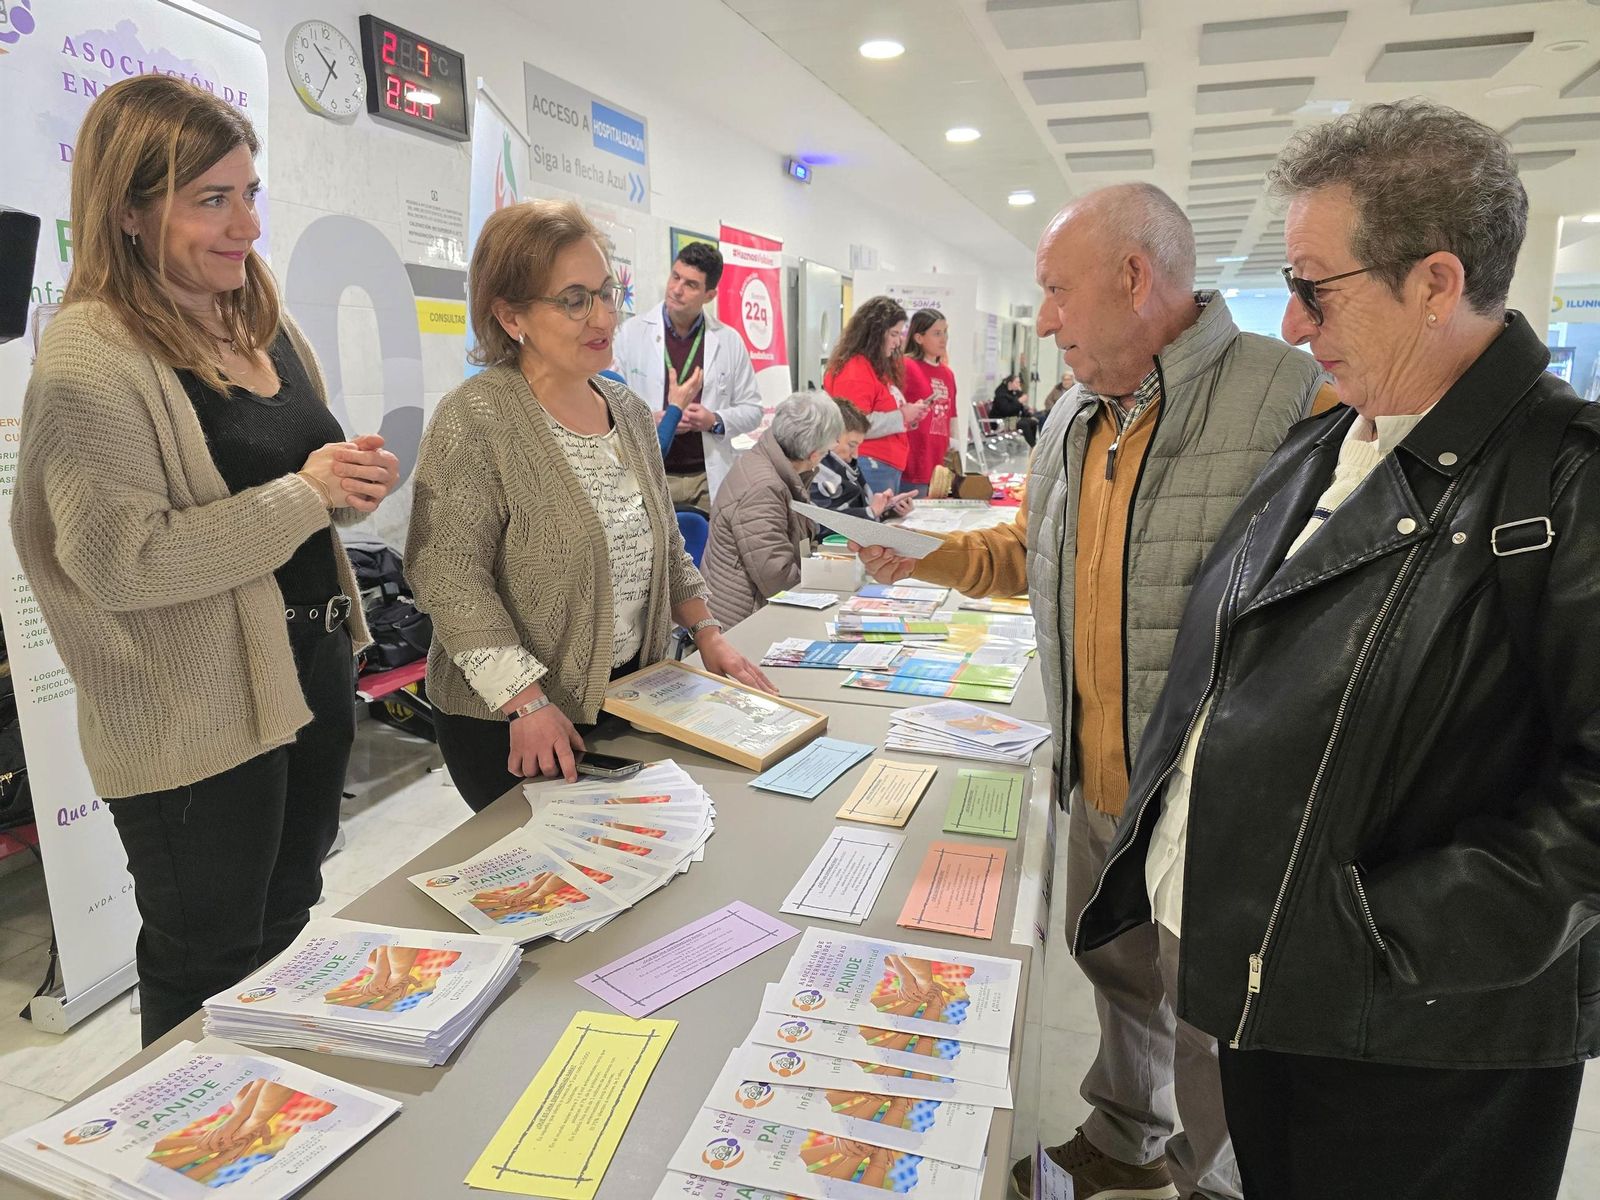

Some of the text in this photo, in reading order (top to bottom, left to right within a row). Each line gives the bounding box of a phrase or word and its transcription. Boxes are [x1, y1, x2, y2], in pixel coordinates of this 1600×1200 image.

[223, 86, 248, 107] DE
[532, 95, 645, 153] ACCESO A HOSPITALIZACIÓN
[534, 144, 627, 191] Siga la flecha Azul
[429, 312, 466, 325] CONSULTAS
[745, 301, 768, 327] 22q
[57, 804, 87, 826] Que
[469, 864, 527, 886] PANIDE
[88, 895, 117, 914] AVDA.
[305, 937, 318, 946] DE
[293, 954, 348, 990] PANIDE
[798, 940, 824, 985] ASOCIACIÓN DE
[805, 941, 832, 987] ENFERMEDADES
[823, 945, 846, 987] DISCAPACIDAD
[835, 956, 862, 993] PANIDE
[291, 982, 330, 1002] Infancia
[847, 983, 865, 1011] Infancia
[105, 1054, 206, 1112] ASOCIACIÓN DE
[111, 1055, 213, 1115] ENFERMEDADES
[129, 1062, 224, 1118] DISCAPACIDAD
[133, 1079, 222, 1129] PANIDE
[114, 1118, 179, 1152] Infancia
[769, 1129, 796, 1171] Infancia
